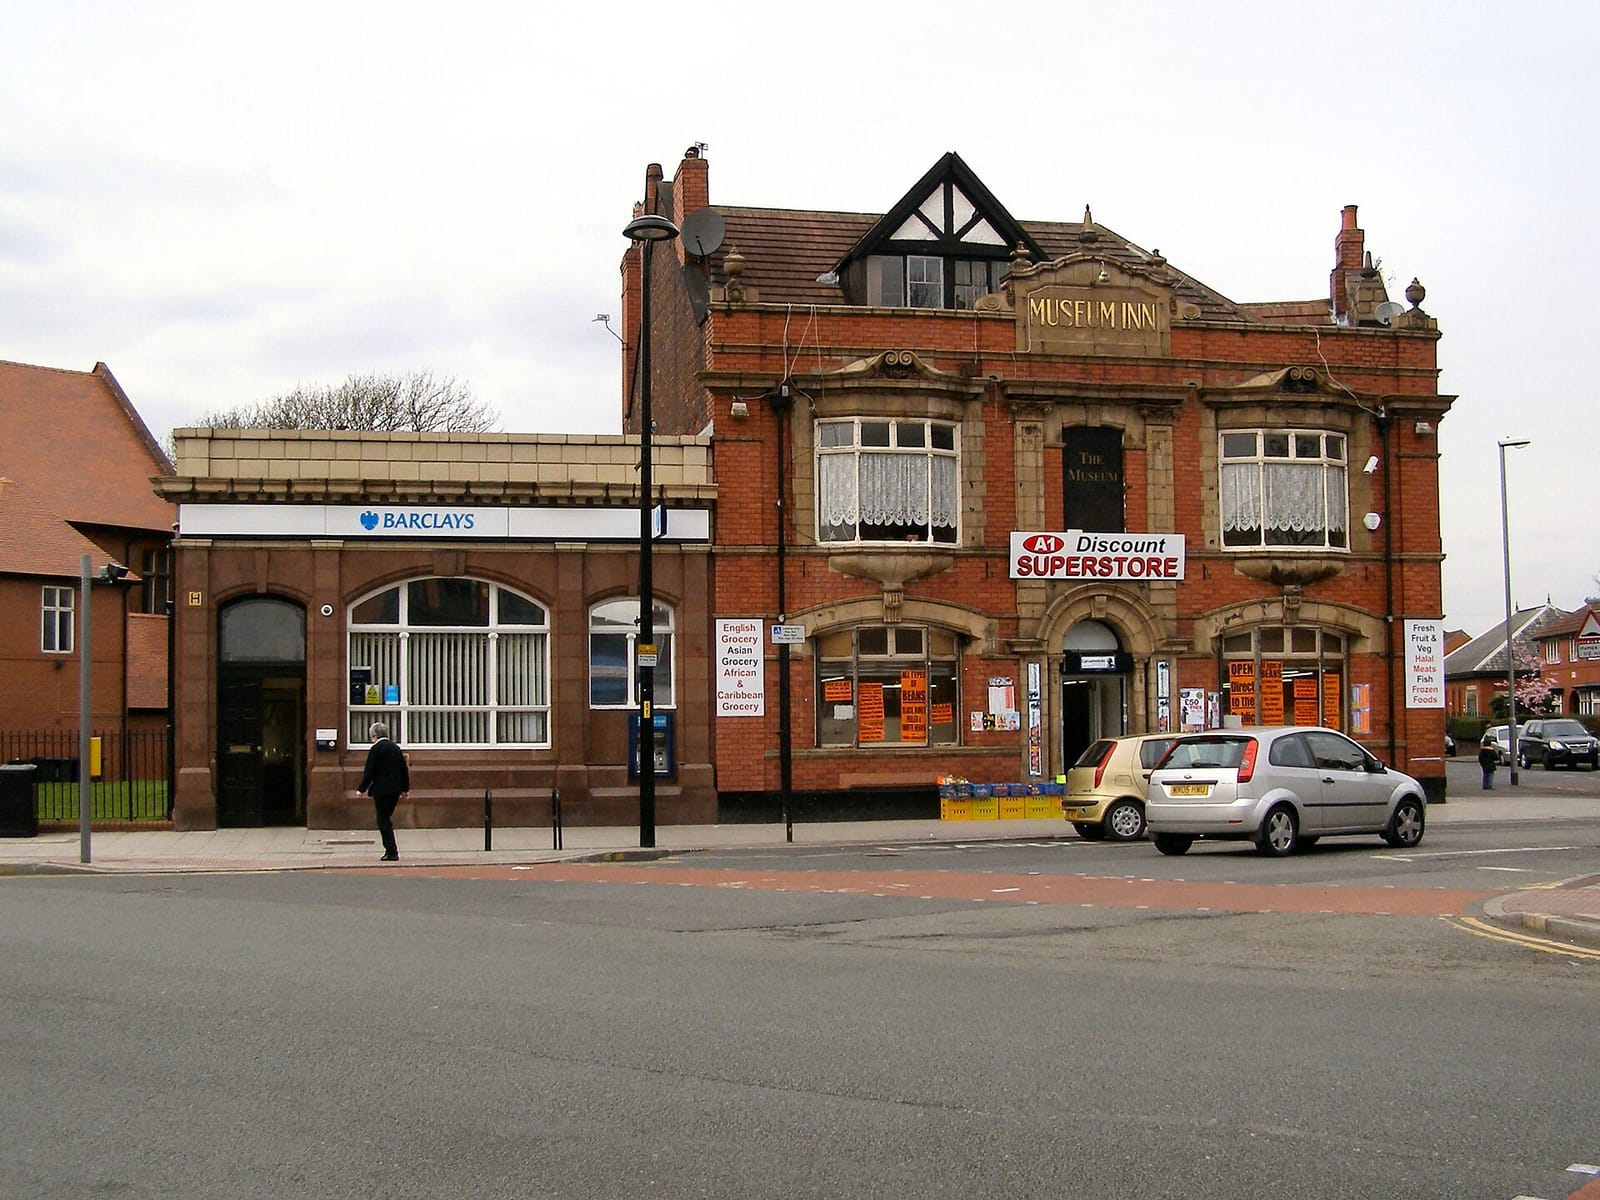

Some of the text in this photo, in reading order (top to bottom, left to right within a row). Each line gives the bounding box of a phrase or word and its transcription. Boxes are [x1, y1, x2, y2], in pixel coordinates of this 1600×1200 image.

[1030, 298, 1157, 331] MUSEUM INN
[1069, 468, 1118, 481] MUSEUM
[383, 513, 475, 529] BARCLAYS
[1034, 536, 1166, 553] A1 Discount
[1017, 555, 1179, 577] SUPERSTORE
[190, 593, 200, 603] H
[723, 623, 756, 633] English
[1413, 624, 1435, 632] Fresh
[721, 635, 758, 645] Grocery
[1411, 634, 1429, 642] Fruit
[727, 646, 753, 655] Asian
[1417, 645, 1432, 653] Veg
[721, 657, 758, 667] Grocery
[1415, 655, 1434, 663] Halal
[724, 668, 757, 677] African
[1231, 663, 1254, 675] OPEN
[1413, 665, 1437, 673] Meats
[736, 680, 744, 688] &
[1417, 675, 1433, 683] Fish
[1231, 681, 1255, 692] Direct
[1412, 685, 1438, 693] Frozen
[717, 691, 763, 700] Caribbean
[902, 690, 926, 701] BEANS
[722, 702, 759, 712] Grocery
[1231, 697, 1241, 707] to
